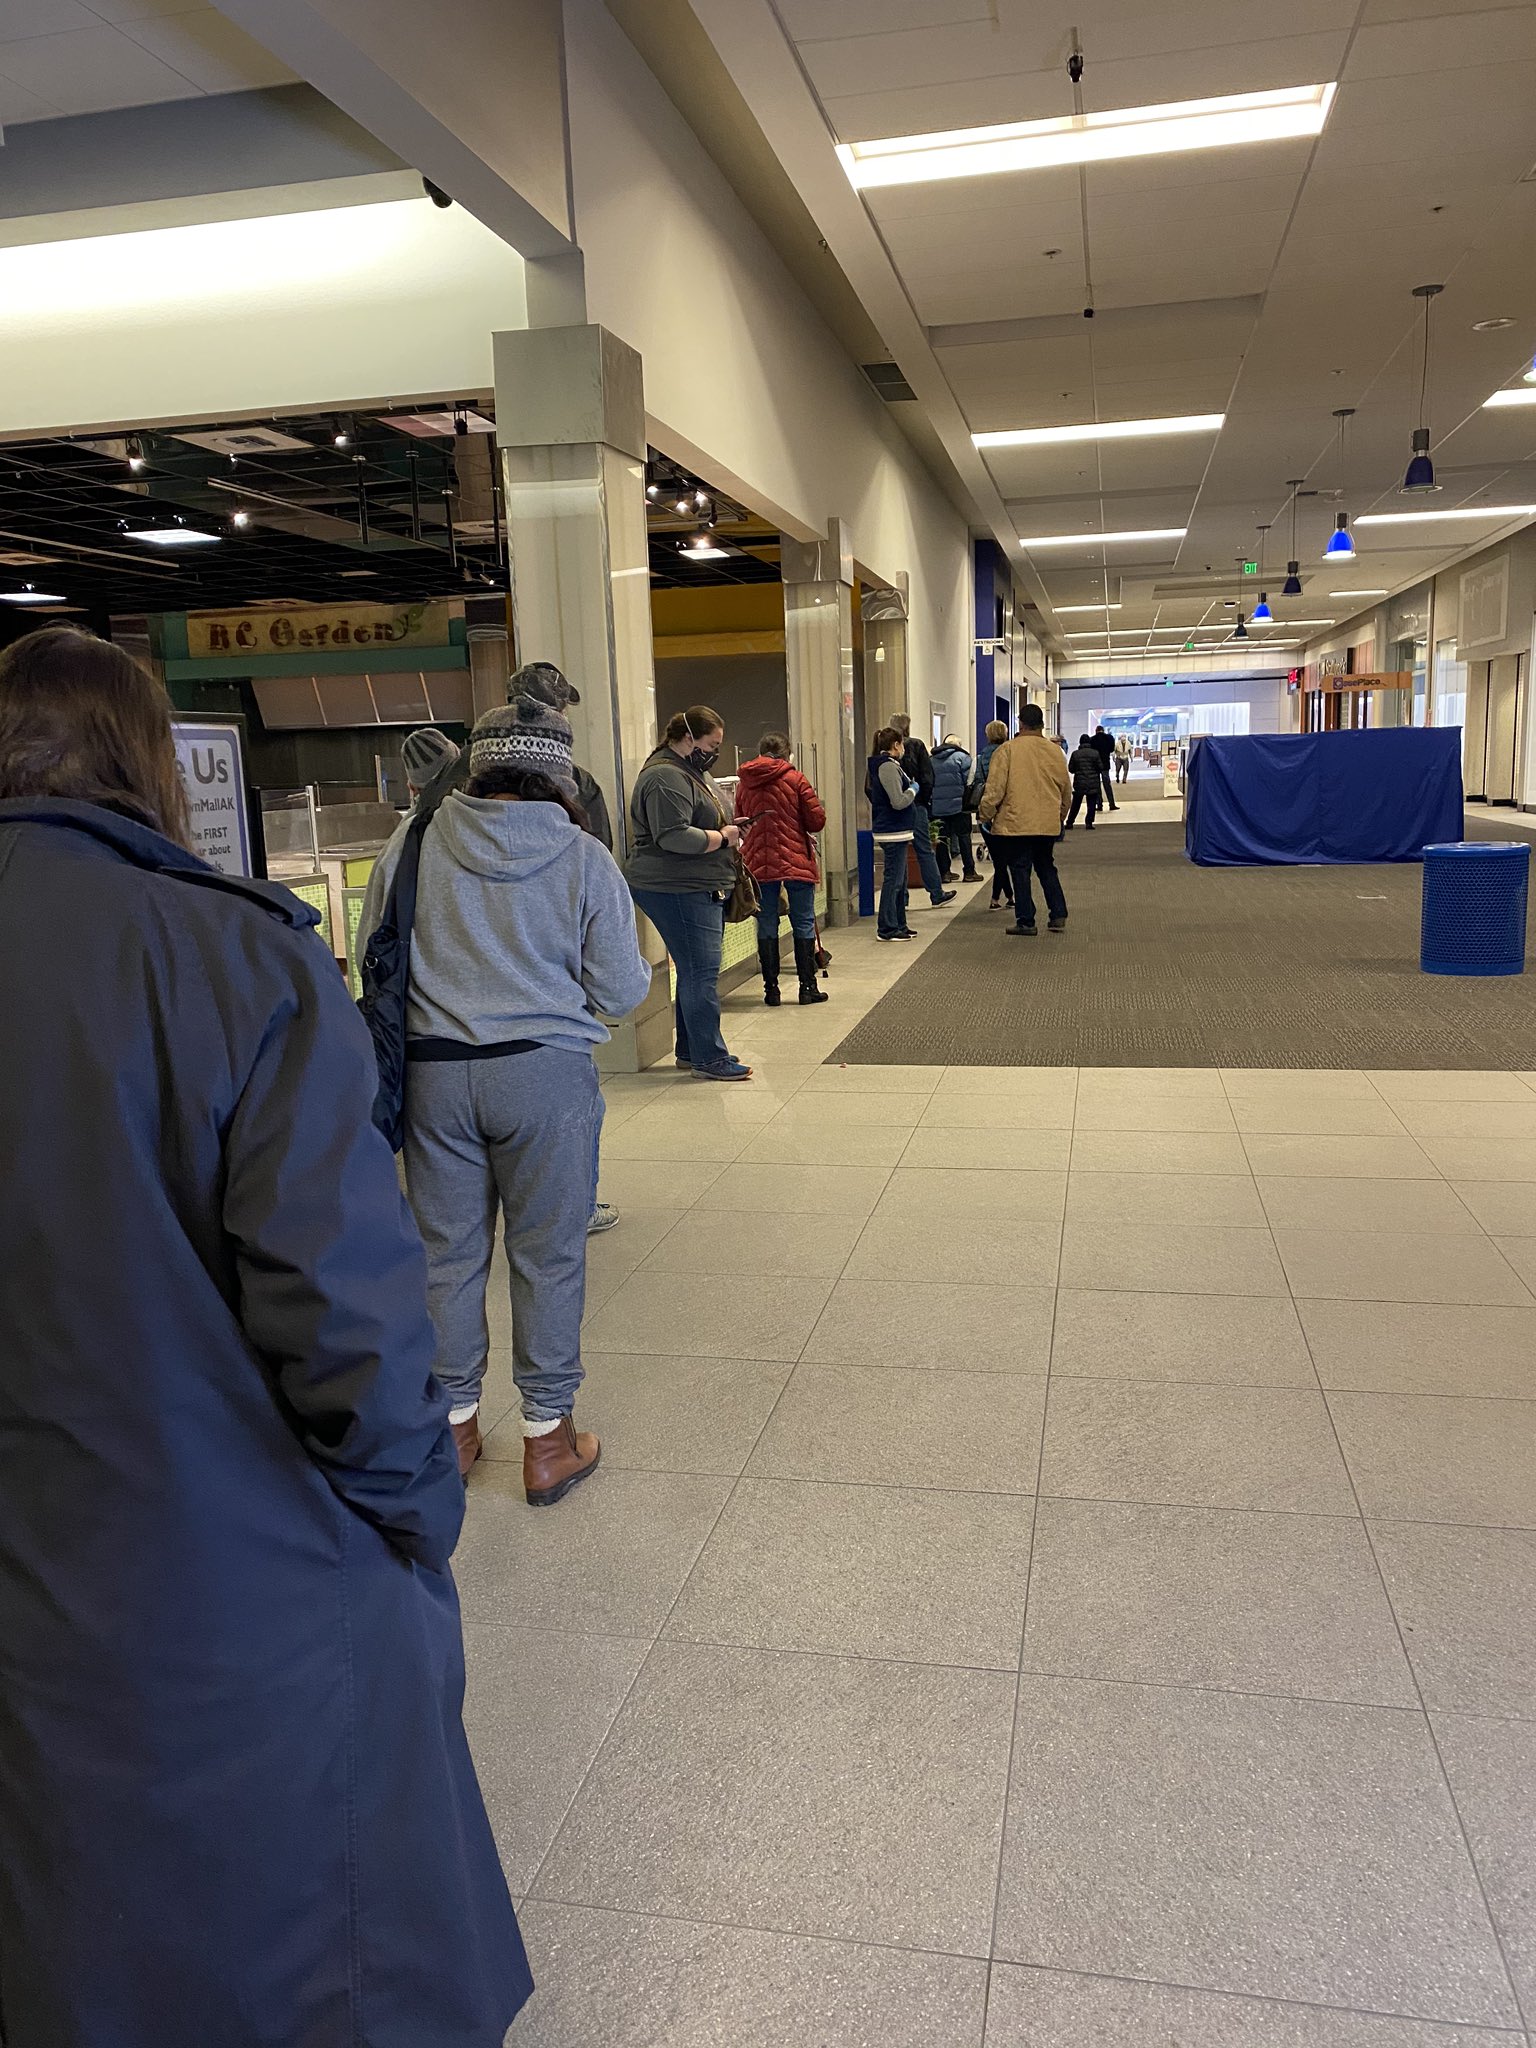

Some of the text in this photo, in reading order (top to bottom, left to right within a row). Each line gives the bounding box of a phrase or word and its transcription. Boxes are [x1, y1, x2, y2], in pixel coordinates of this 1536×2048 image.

[191, 747, 229, 784] Us
[203, 826, 228, 840] FIRST
[207, 844, 231, 856] about
